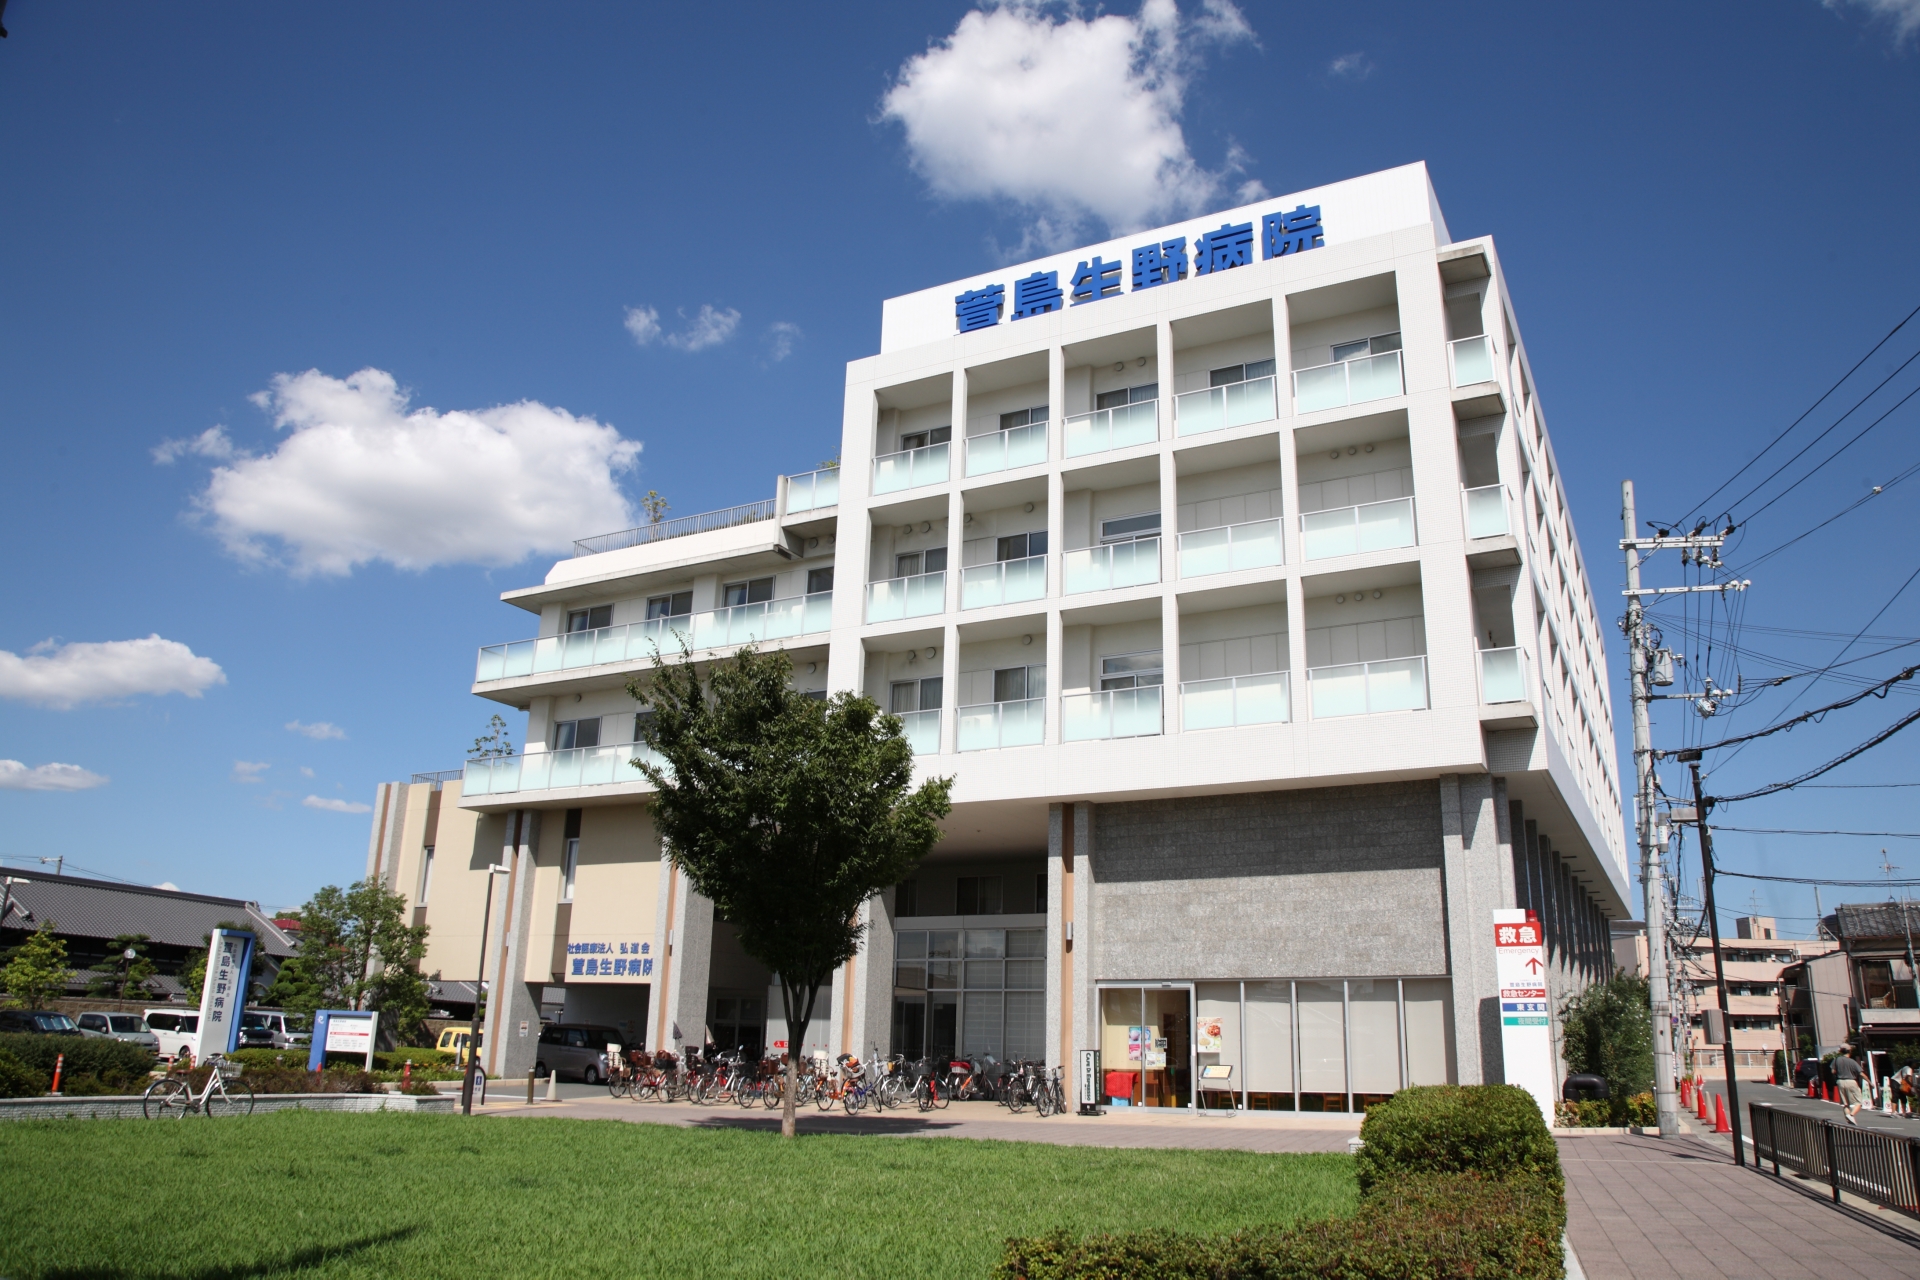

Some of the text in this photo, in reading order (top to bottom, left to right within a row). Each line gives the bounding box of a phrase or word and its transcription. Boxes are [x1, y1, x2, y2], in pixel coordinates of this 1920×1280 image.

[955, 204, 1325, 334] 萱島生野病院
[1498, 926, 1537, 944] 救急
[567, 942, 650, 954] 社会医療法人 弘道会
[1498, 947, 1539, 955] Emergency
[212, 941, 234, 1022] 萱島生野病院
[1502, 990, 1544, 998] 救急センター
